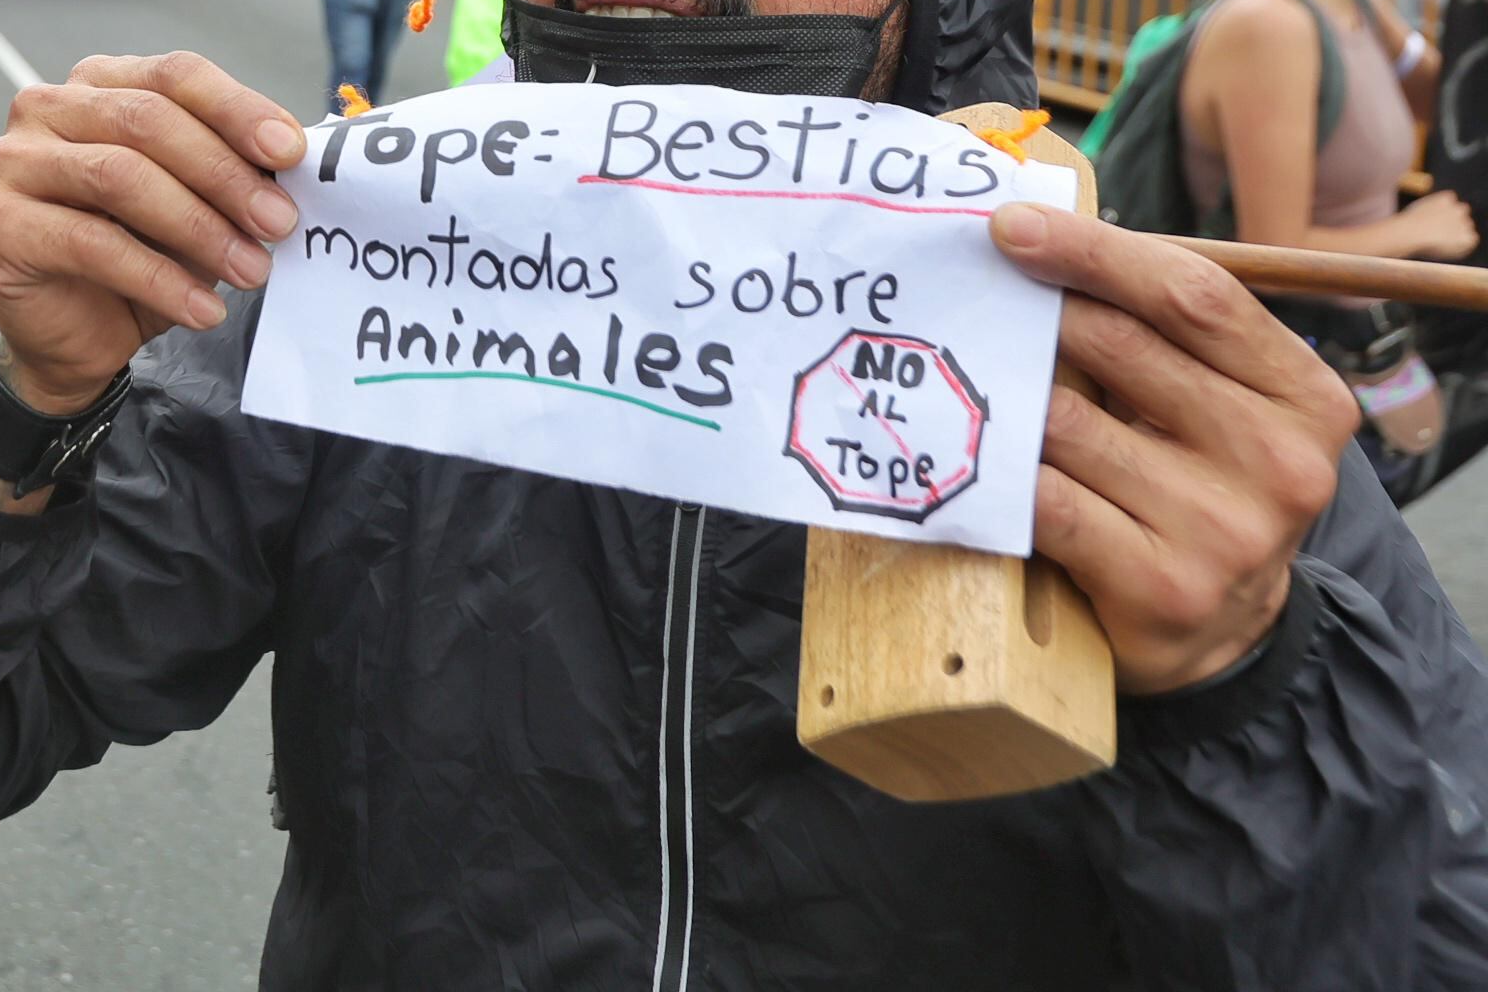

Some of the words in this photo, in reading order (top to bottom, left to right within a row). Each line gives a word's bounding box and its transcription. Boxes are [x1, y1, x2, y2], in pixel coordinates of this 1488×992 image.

[598, 100, 999, 198] Bestias
[305, 215, 618, 299] montadas
[674, 251, 899, 324] sobre
[356, 306, 734, 407] Animales
[850, 341, 925, 388] NO
[858, 390, 907, 423] AL
[826, 437, 937, 499] Tope
